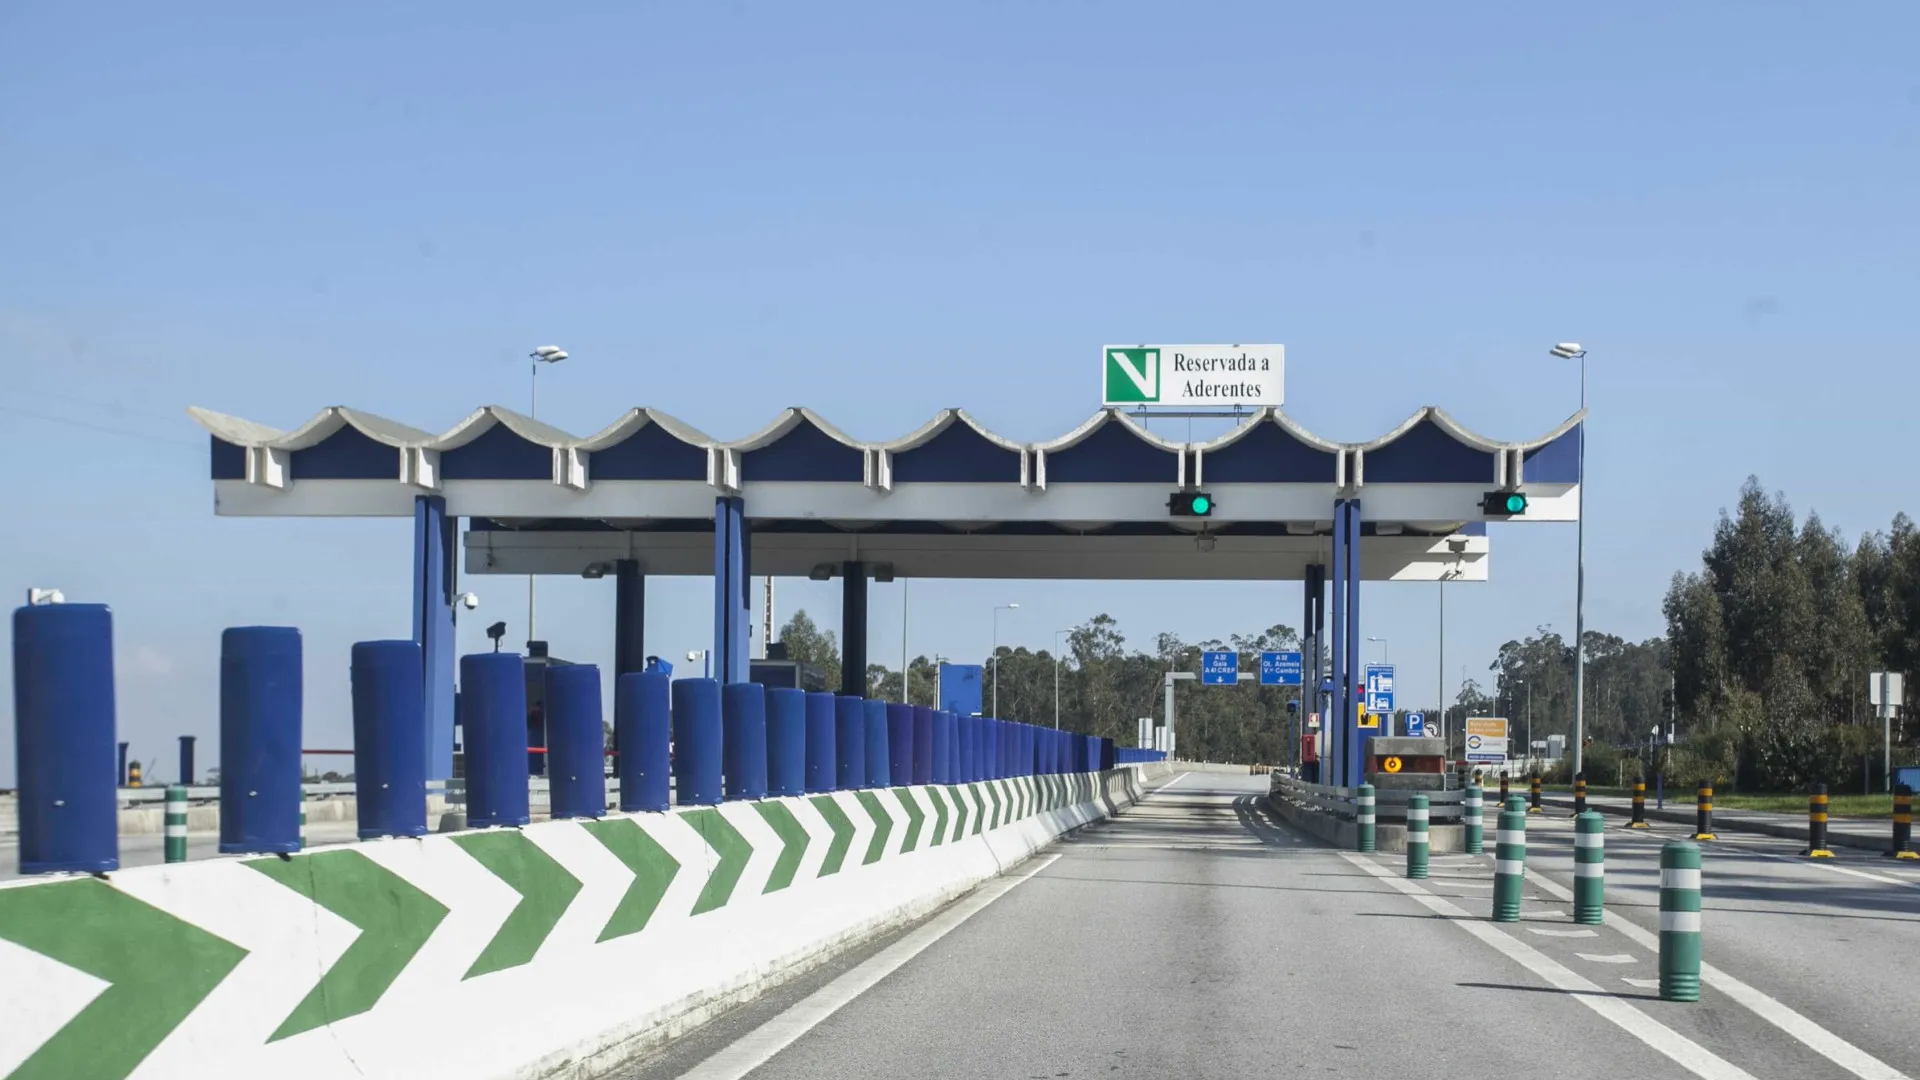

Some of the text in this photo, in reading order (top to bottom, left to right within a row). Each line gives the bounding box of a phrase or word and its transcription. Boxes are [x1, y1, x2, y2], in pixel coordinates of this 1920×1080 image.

[1175, 353, 1269, 371] Reservada a
[1182, 380, 1262, 398] Aderentes
[1409, 714, 1420, 729] P
